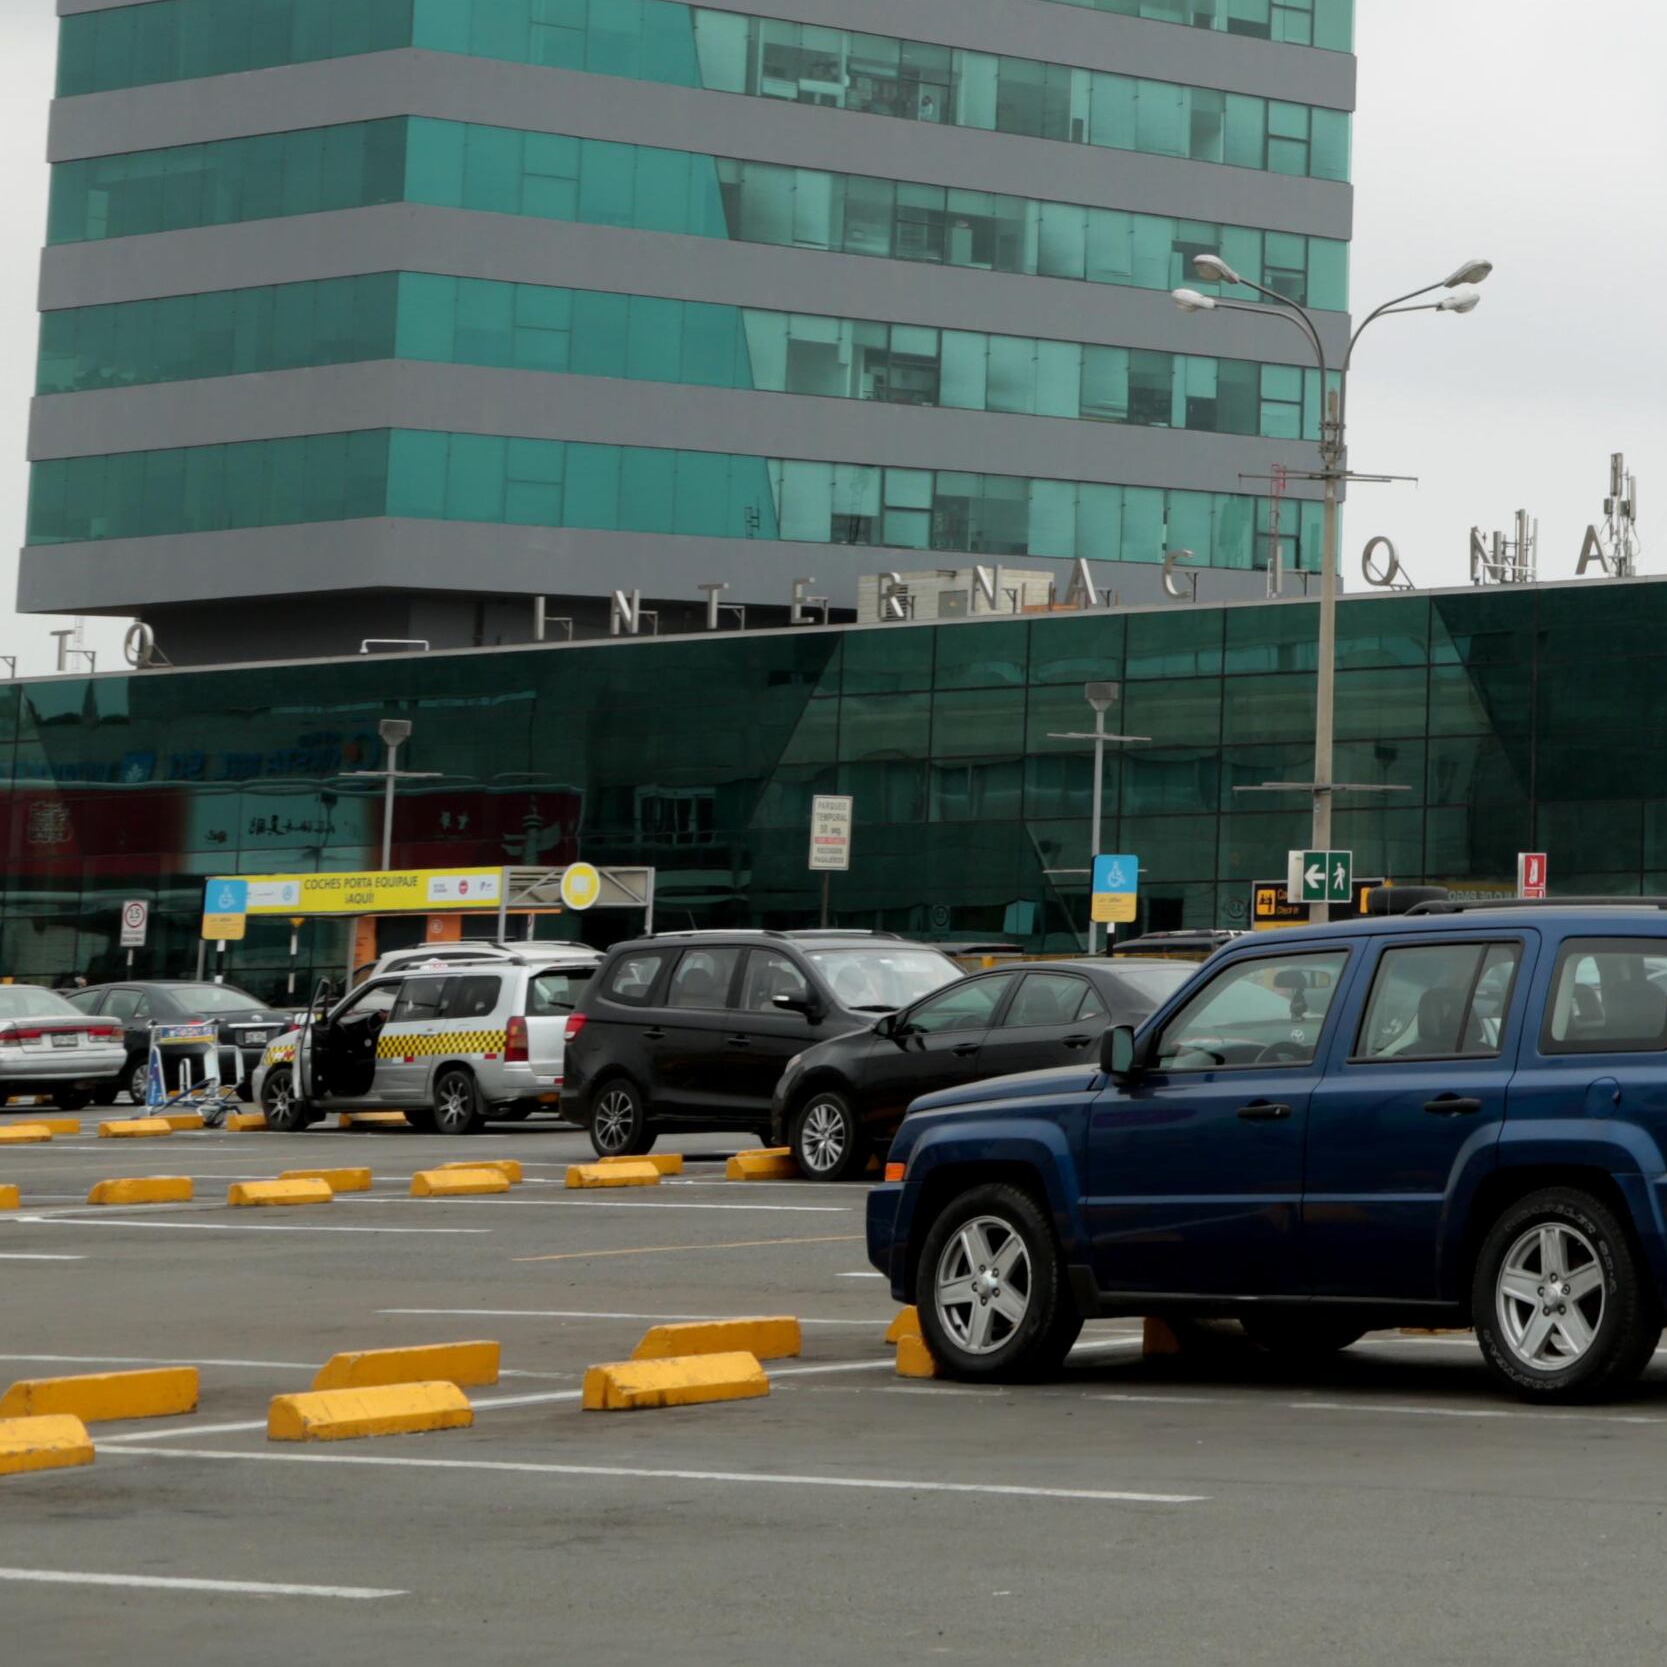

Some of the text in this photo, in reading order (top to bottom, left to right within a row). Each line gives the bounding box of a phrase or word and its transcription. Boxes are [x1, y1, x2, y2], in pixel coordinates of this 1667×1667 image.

[303, 877, 341, 891] COCHES
[343, 876, 373, 889] PORTA
[375, 875, 418, 889] EQUIPAJE
[129, 908, 141, 920] 15
